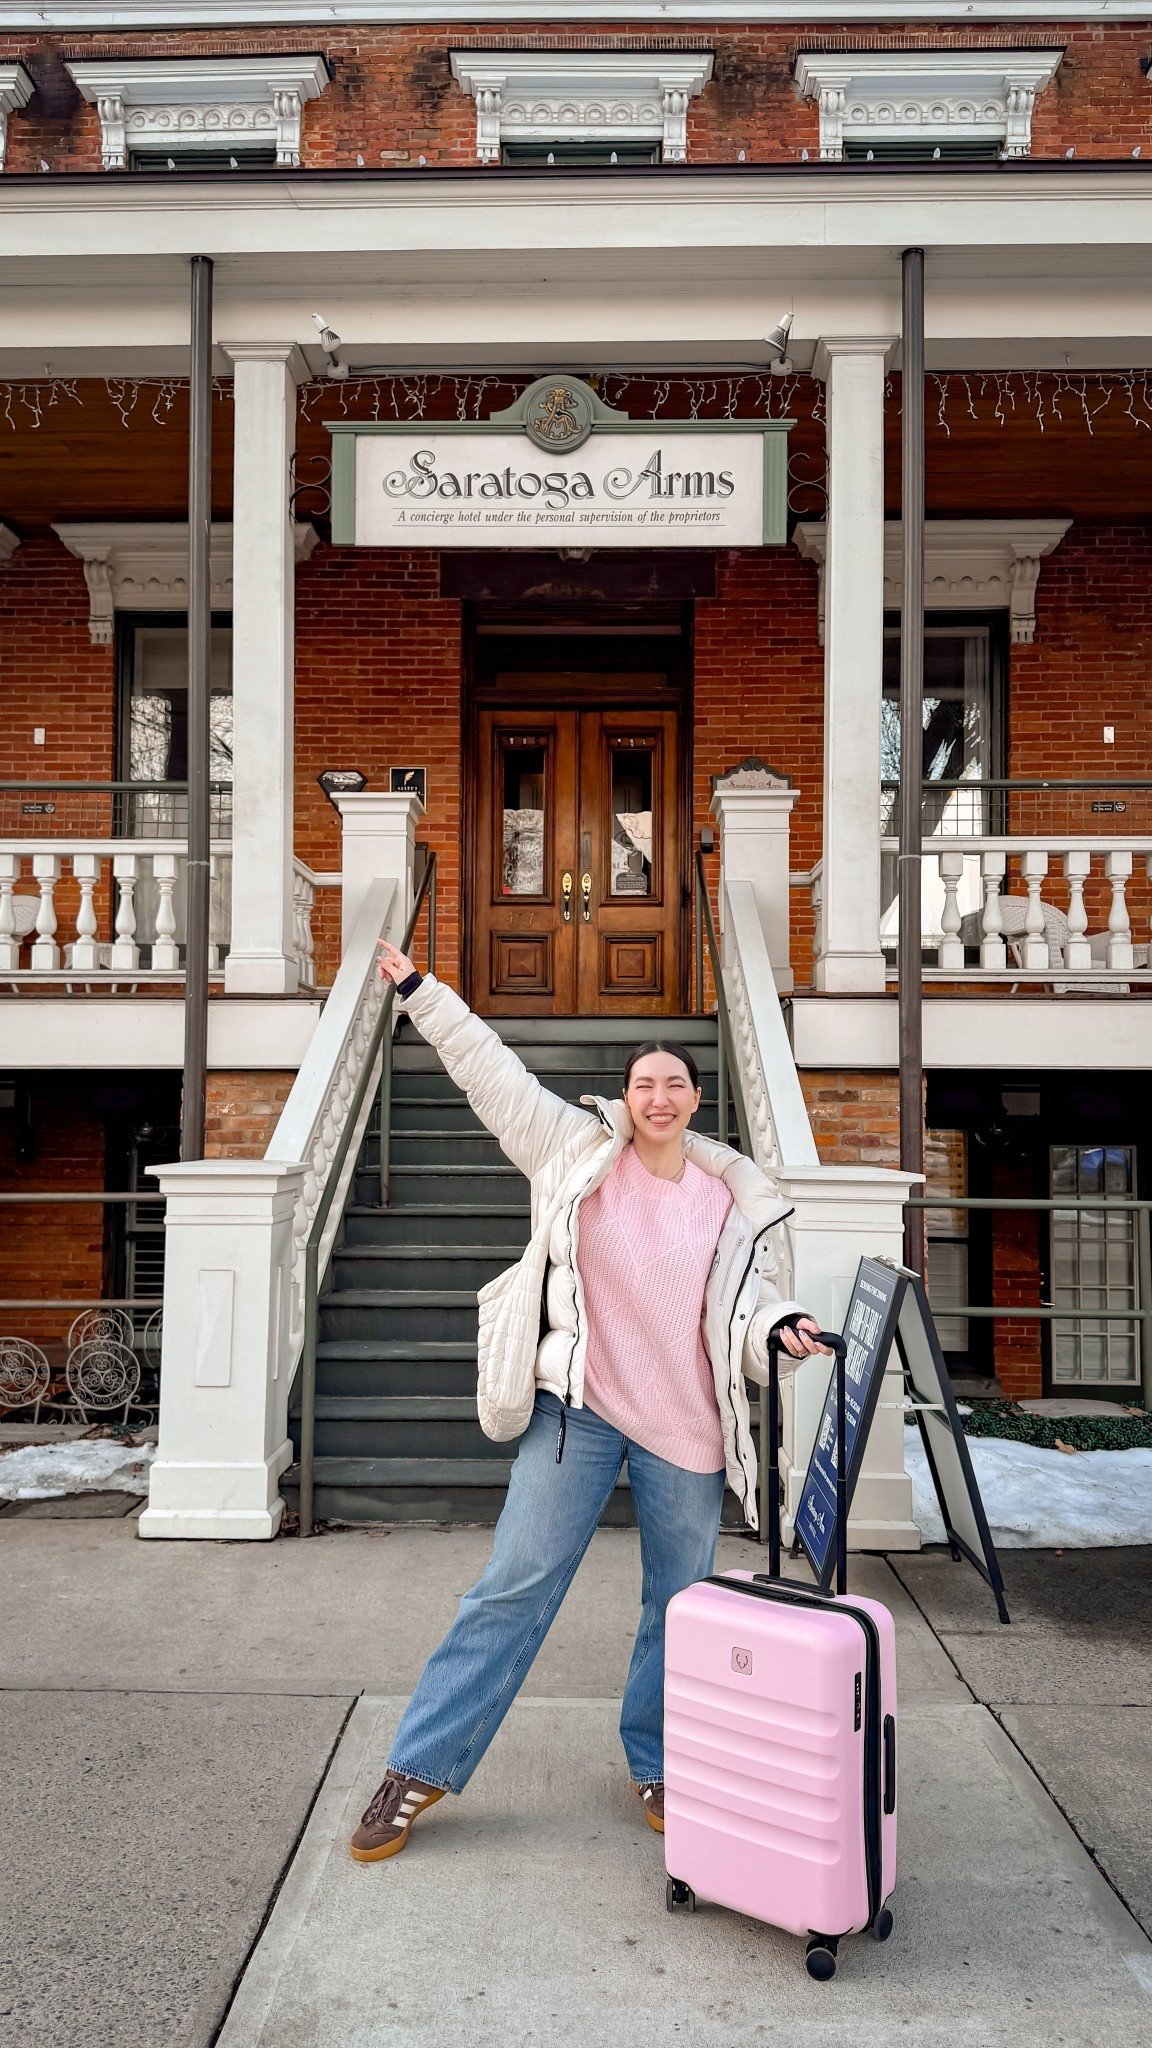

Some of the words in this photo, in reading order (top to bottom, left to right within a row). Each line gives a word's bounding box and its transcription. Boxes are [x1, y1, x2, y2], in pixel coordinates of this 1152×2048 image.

[382, 450, 595, 510] Saratoga
[603, 449, 735, 500] Arms
[398, 511, 406, 522] A
[410, 511, 454, 524] concierge
[458, 511, 481, 522] hotel
[485, 511, 514, 522] under
[517, 511, 532, 522] the
[535, 511, 575, 524] personal
[579, 511, 633, 524] supervision
[637, 511, 649, 524] of
[651, 511, 665, 522] the
[668, 510, 721, 524] proprietors
